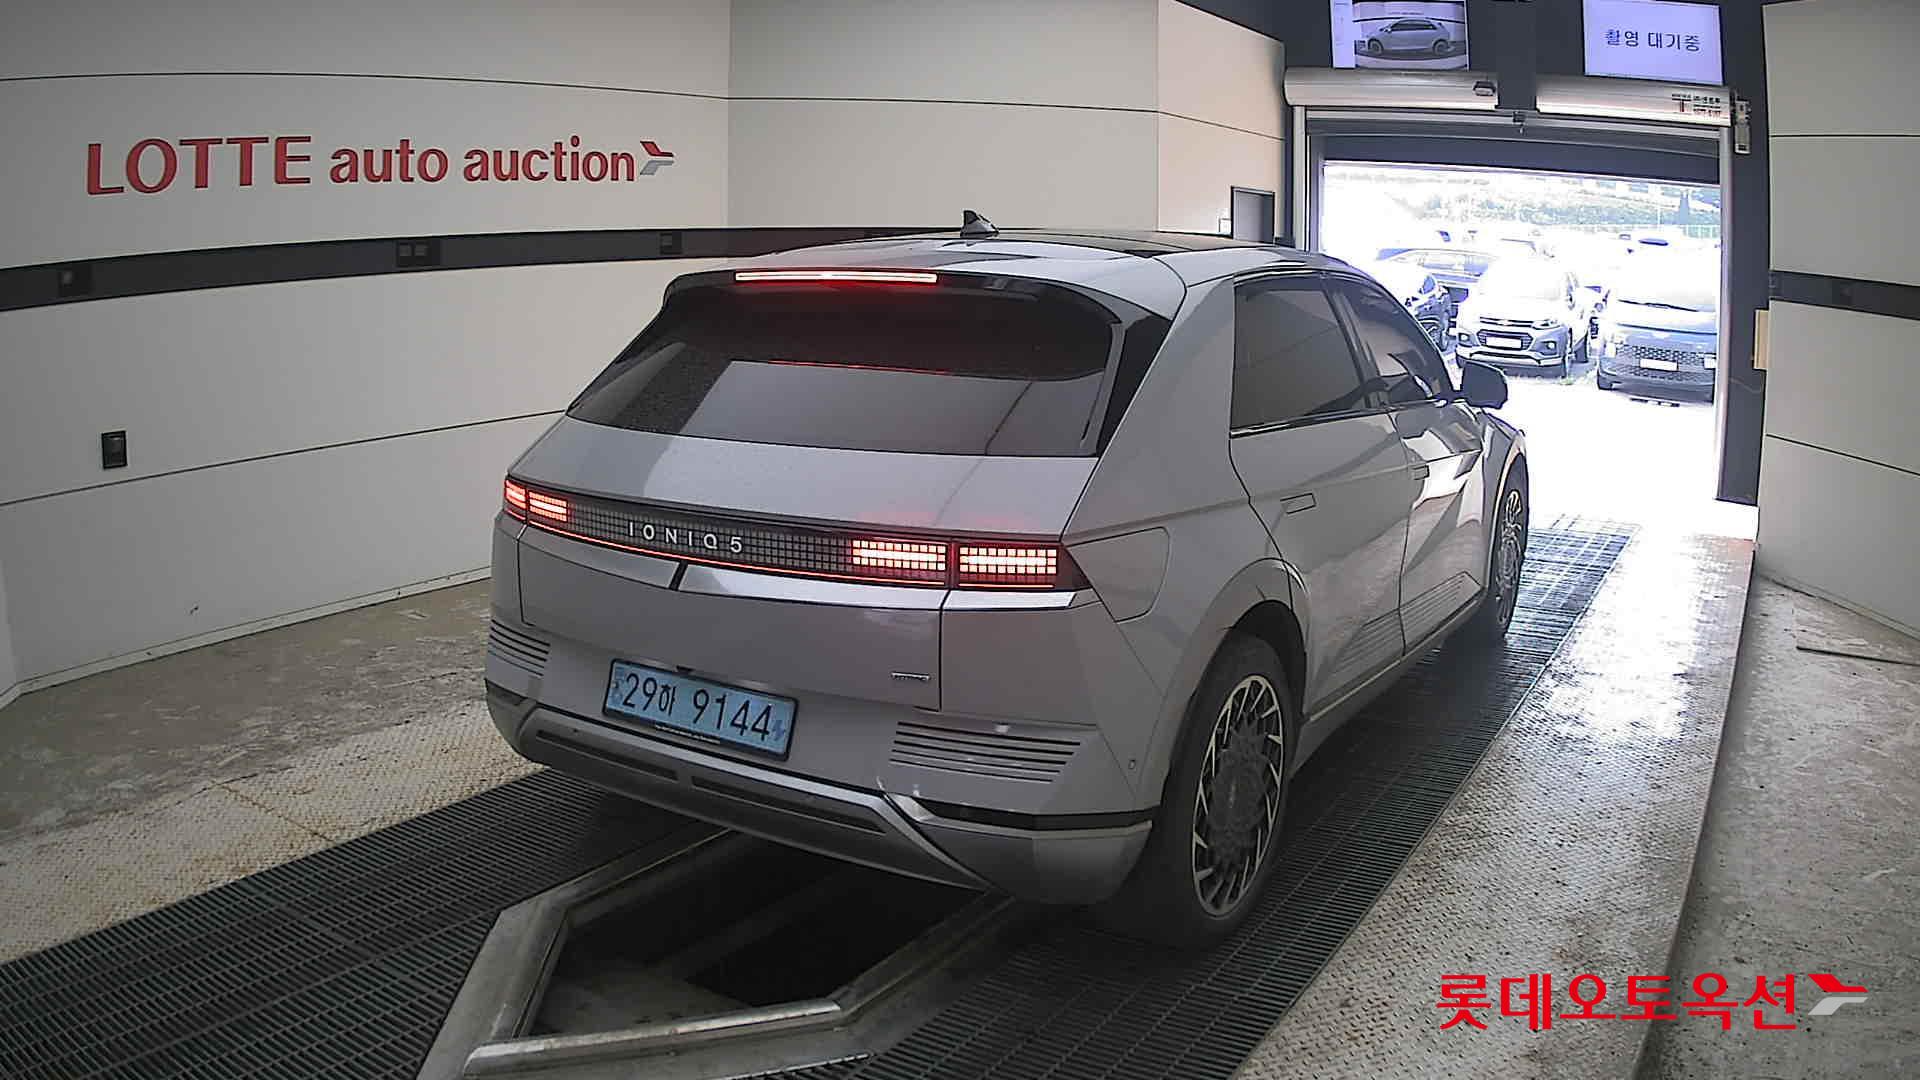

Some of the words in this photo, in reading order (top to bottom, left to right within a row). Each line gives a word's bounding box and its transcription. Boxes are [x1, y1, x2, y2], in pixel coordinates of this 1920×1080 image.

[1647, 31, 1701, 52] 대기중
[86, 135, 311, 195] LOTTE
[329, 138, 448, 183] auto
[463, 135, 634, 182] auction
[629, 521, 718, 550] IONIQ
[730, 536, 743, 553] 5
[622, 673, 677, 717] 29하
[693, 688, 773, 741] 9144
